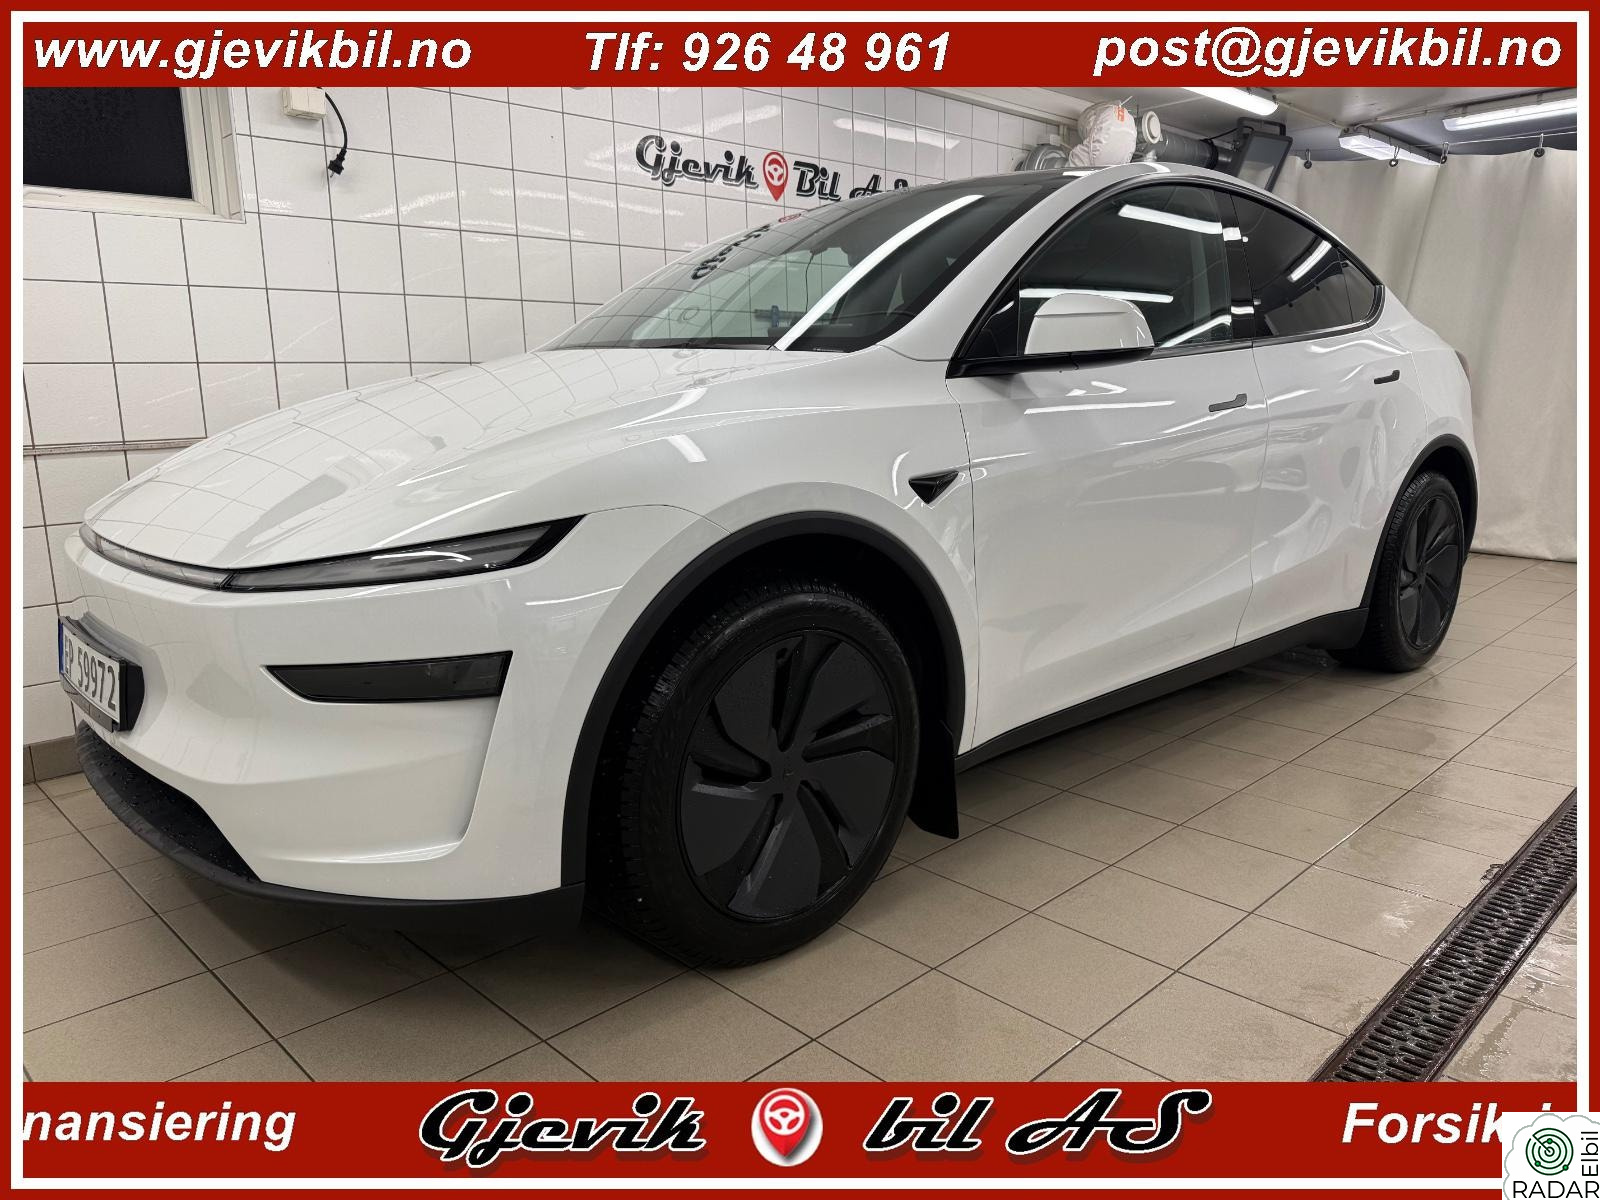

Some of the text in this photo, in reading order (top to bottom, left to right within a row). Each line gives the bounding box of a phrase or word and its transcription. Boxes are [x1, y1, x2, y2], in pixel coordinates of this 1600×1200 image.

[635, 134, 758, 187] Gjevik
[793, 160, 843, 201] Bil
[77, 646, 116, 712] 59972
